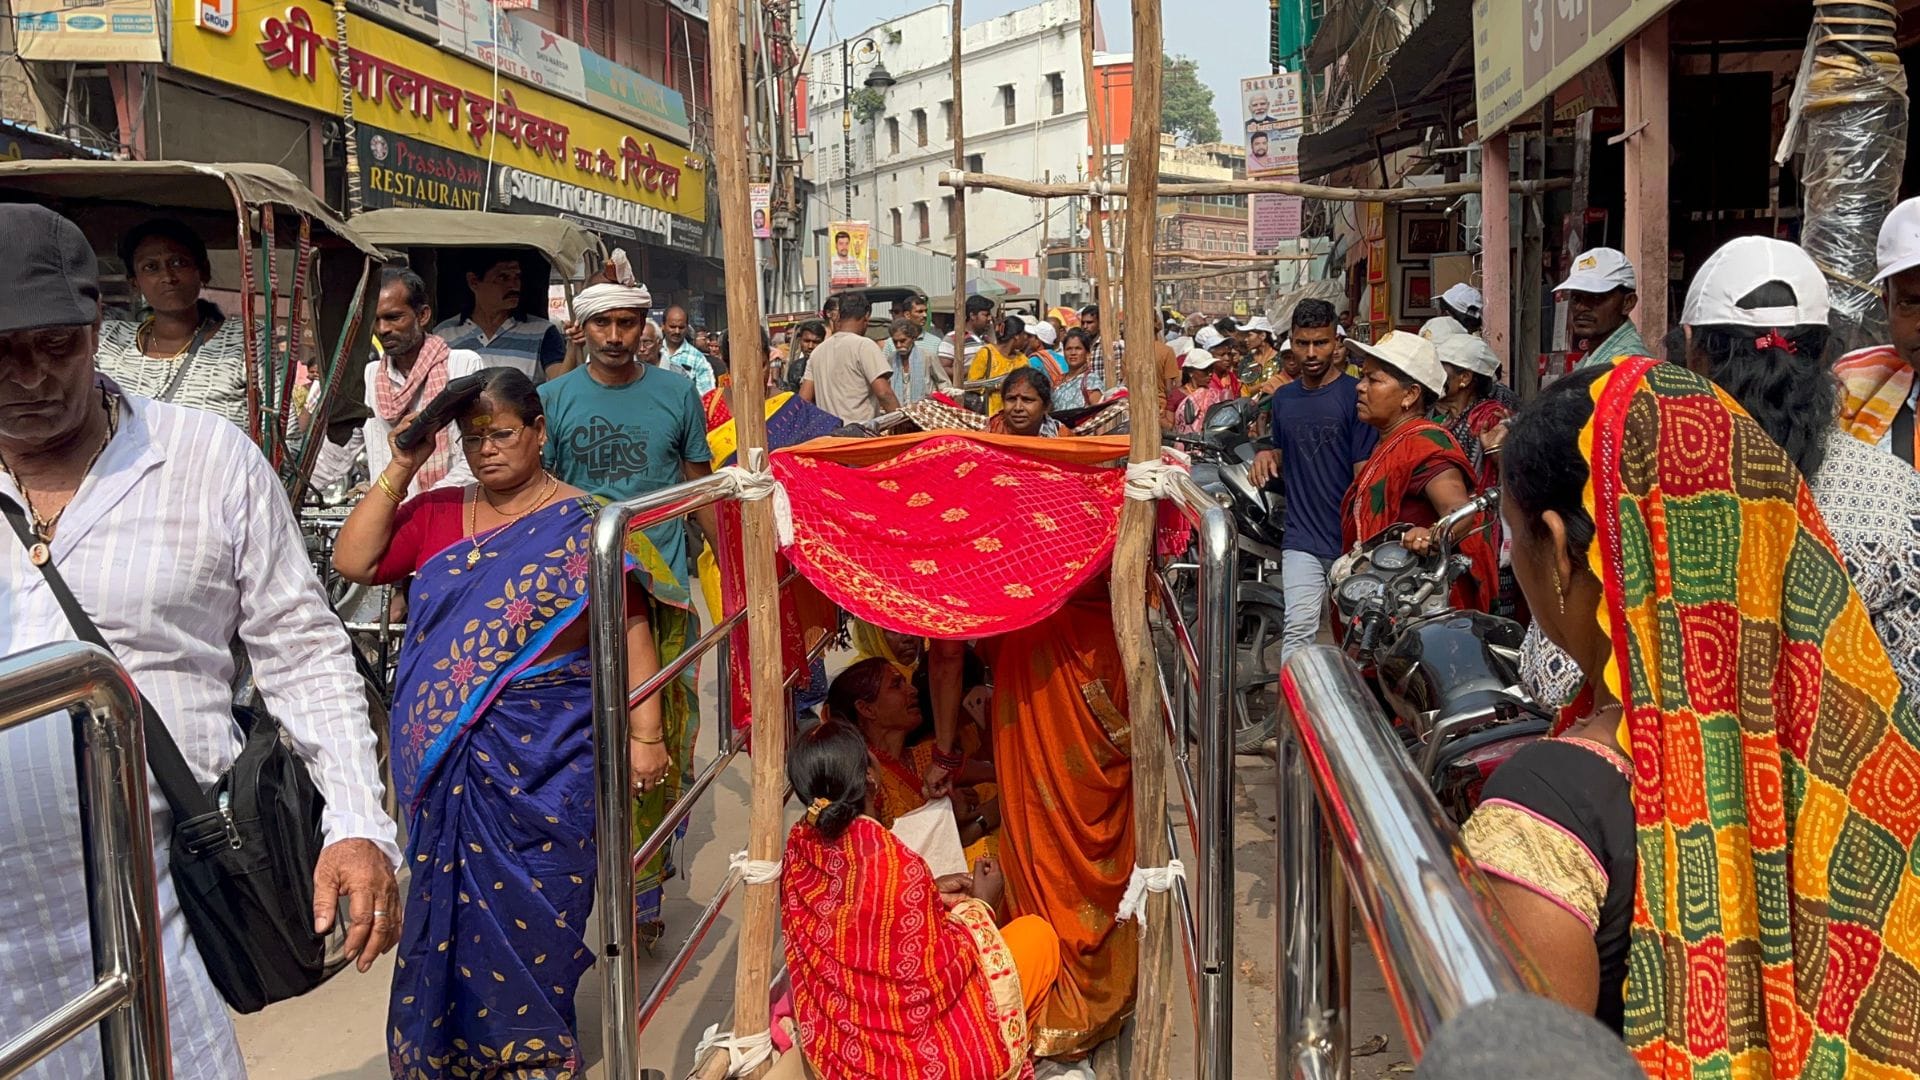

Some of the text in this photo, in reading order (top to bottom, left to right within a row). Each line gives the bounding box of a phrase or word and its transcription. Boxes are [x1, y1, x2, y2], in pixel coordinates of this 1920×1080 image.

[204, 12, 229, 28] GROUP
[477, 47, 518, 73] RAPUT
[520, 69, 530, 79] &
[257, 7, 322, 83] श्री
[619, 135, 680, 200] रिटेल
[370, 166, 481, 211] RESTAURANT
[570, 415, 632, 455] CITY
[588, 440, 648, 474] LEAKS
